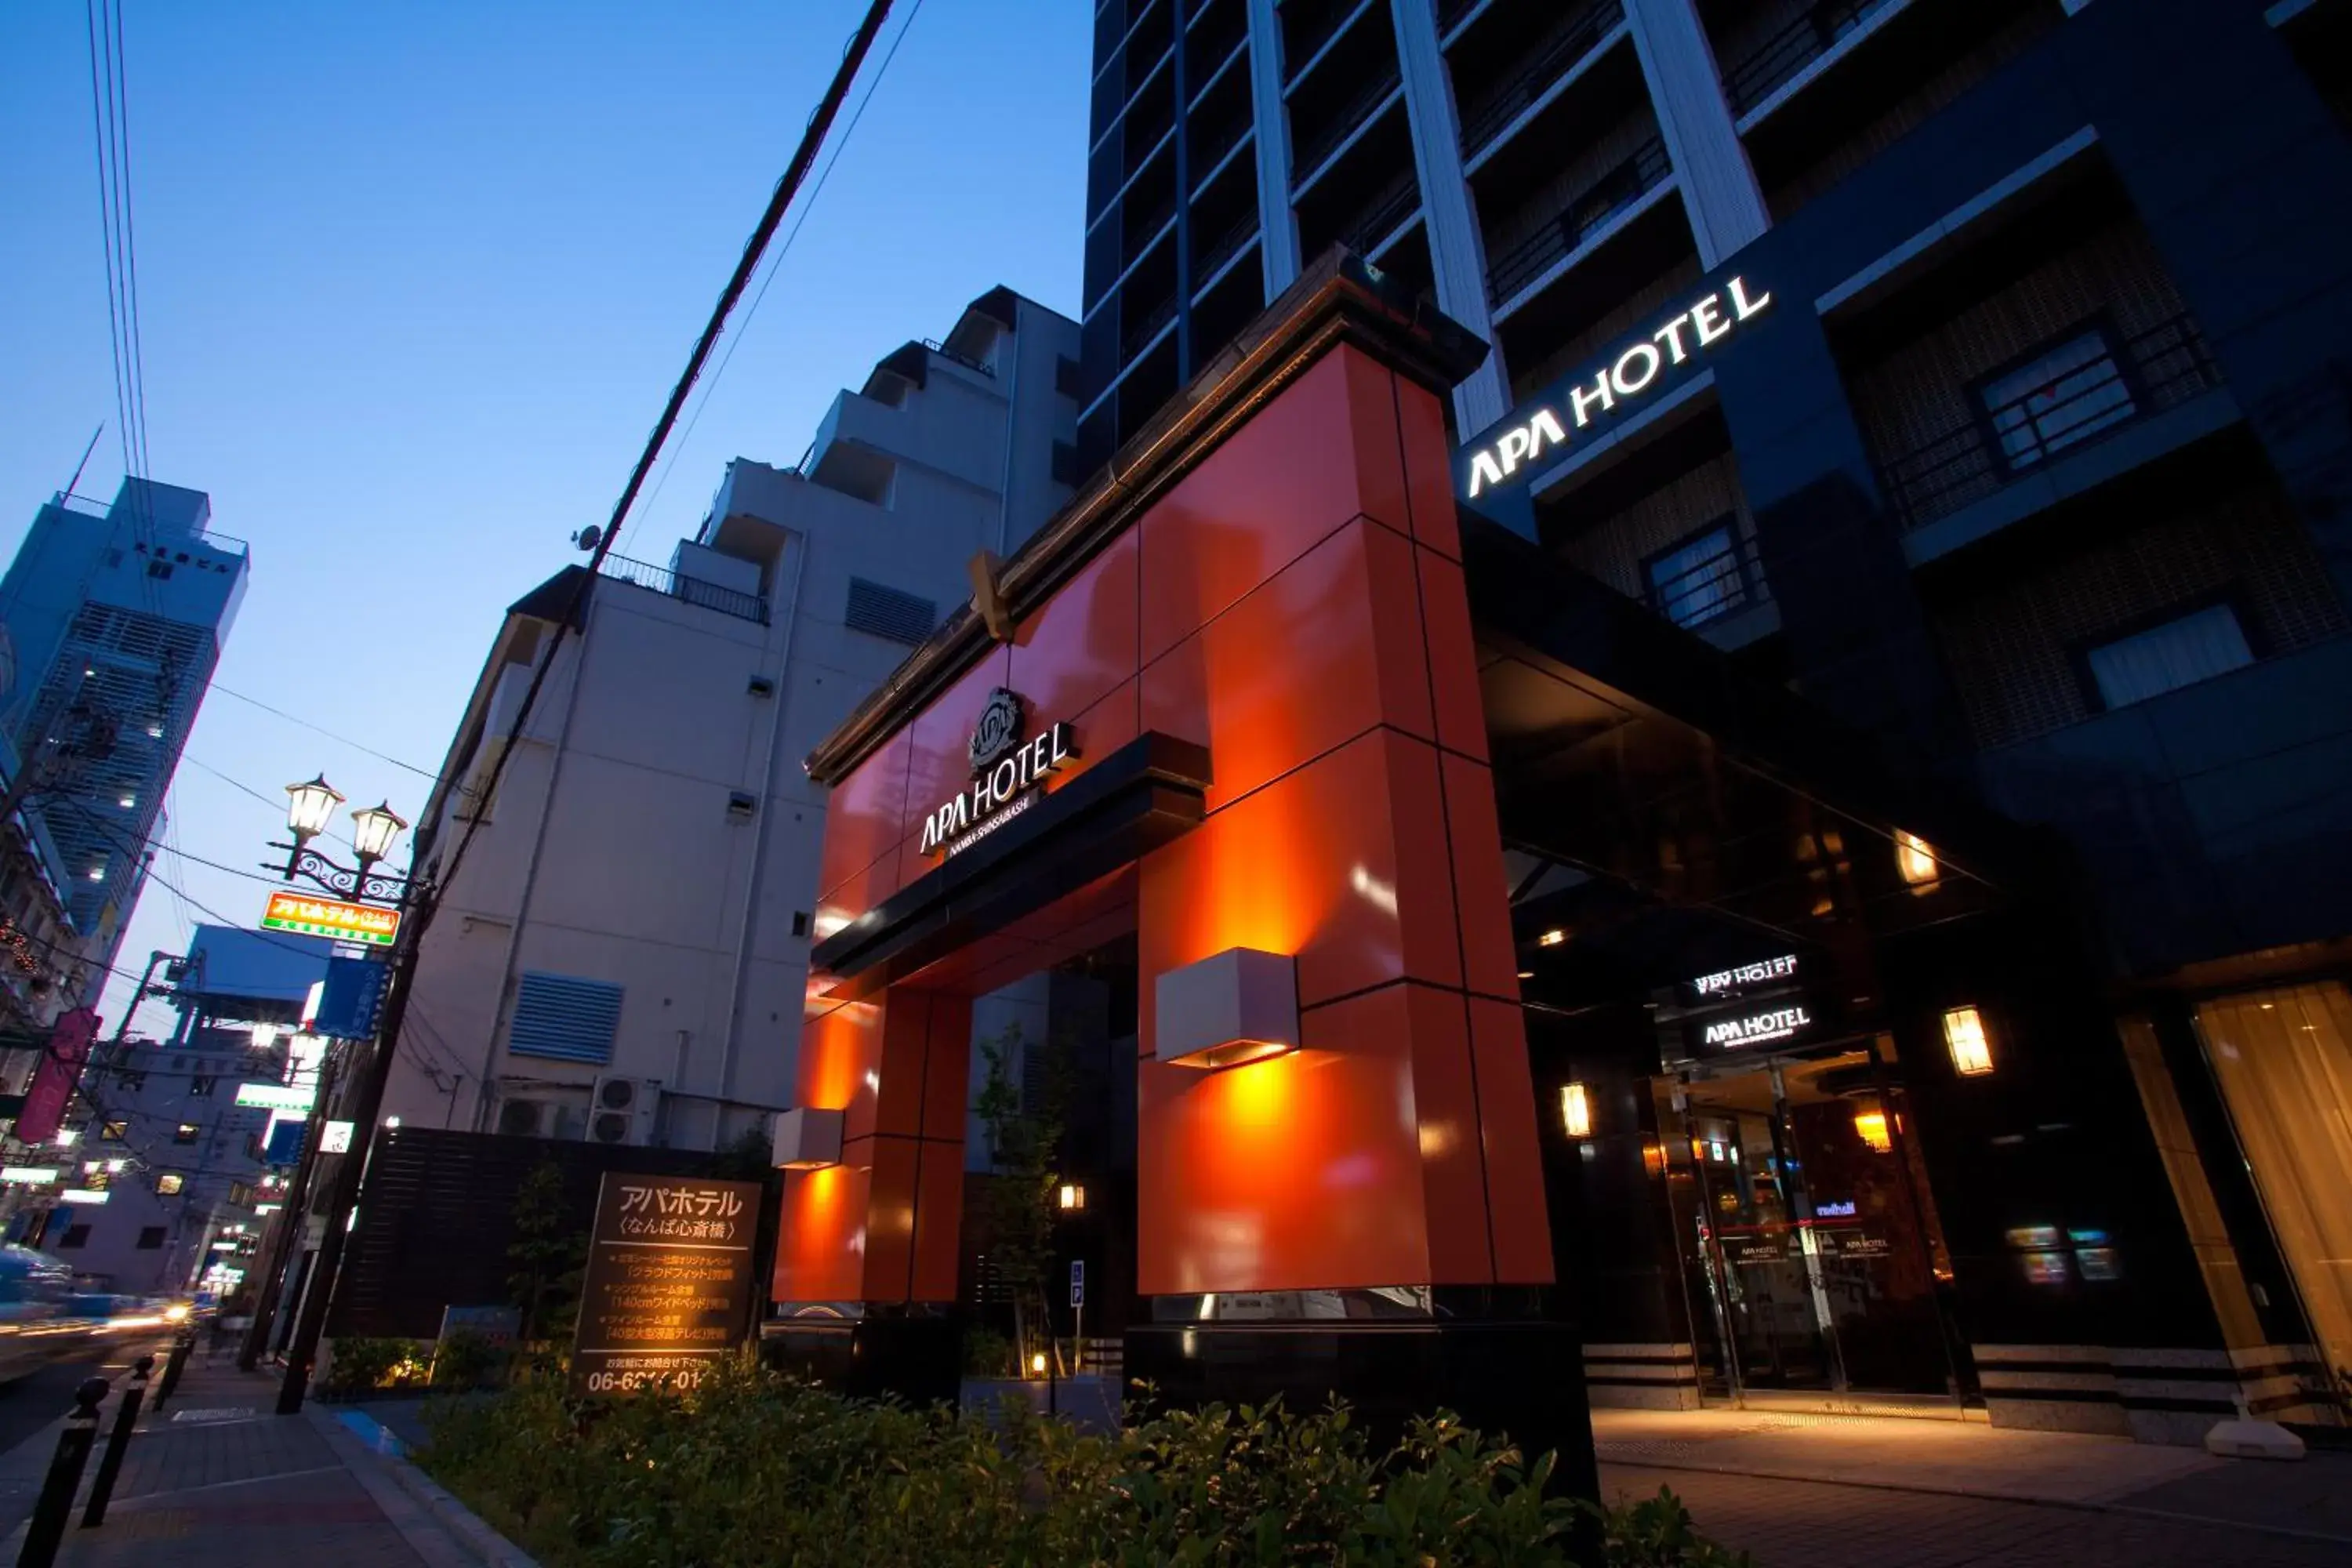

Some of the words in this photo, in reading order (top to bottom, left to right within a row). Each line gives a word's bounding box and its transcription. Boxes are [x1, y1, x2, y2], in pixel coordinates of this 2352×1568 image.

[1468, 408, 1566, 499] APA
[1569, 275, 1770, 428] HOTEL
[920, 792, 968, 854] APA
[973, 723, 1067, 821] HOTEL
[1705, 1021, 1743, 1044] APA
[1743, 1007, 1810, 1036] HOTEL
[620, 1186, 743, 1217] アパホテル
